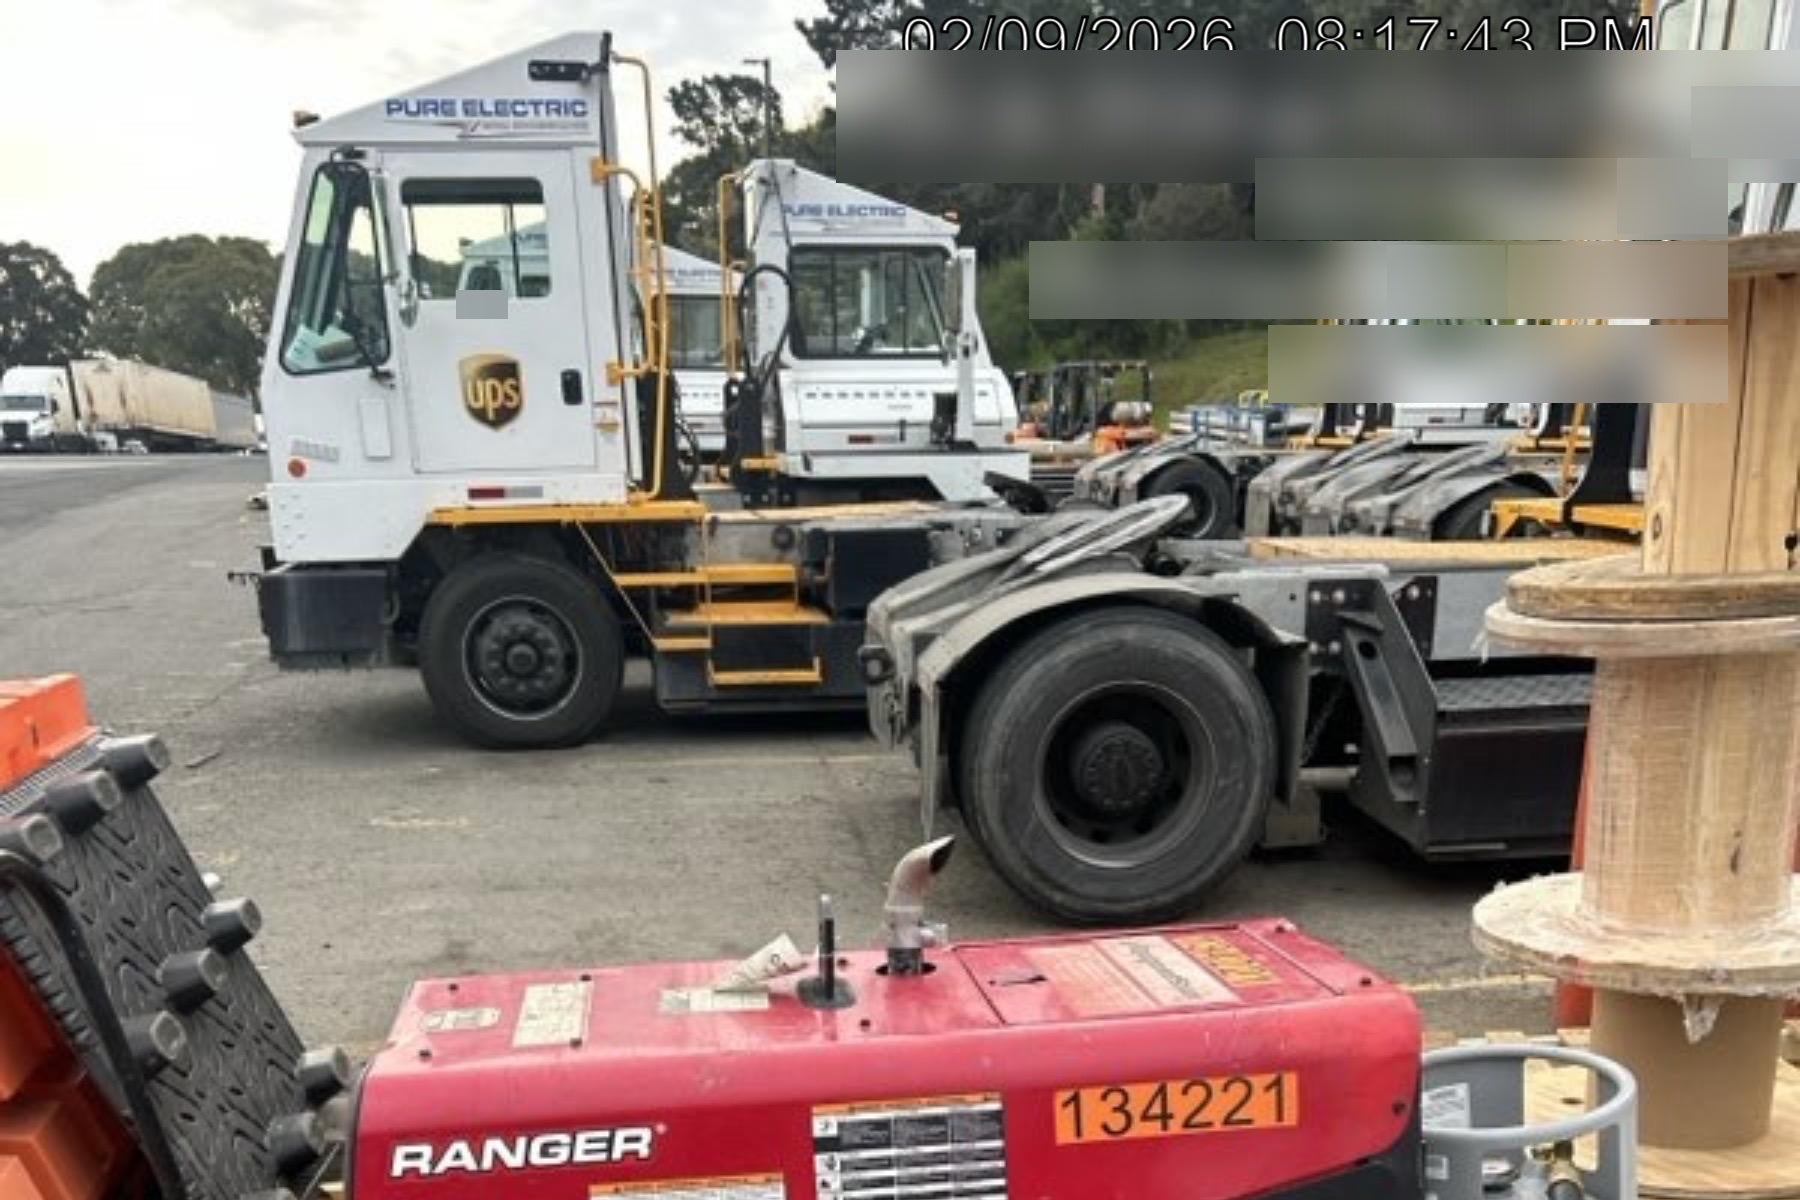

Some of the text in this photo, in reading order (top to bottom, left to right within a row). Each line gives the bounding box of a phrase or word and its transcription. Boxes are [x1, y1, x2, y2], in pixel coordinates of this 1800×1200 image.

[386, 98, 588, 117] PURE ELECTRIC
[1061, 1072, 1286, 1139] 134221
[391, 1126, 652, 1177] RANGER
